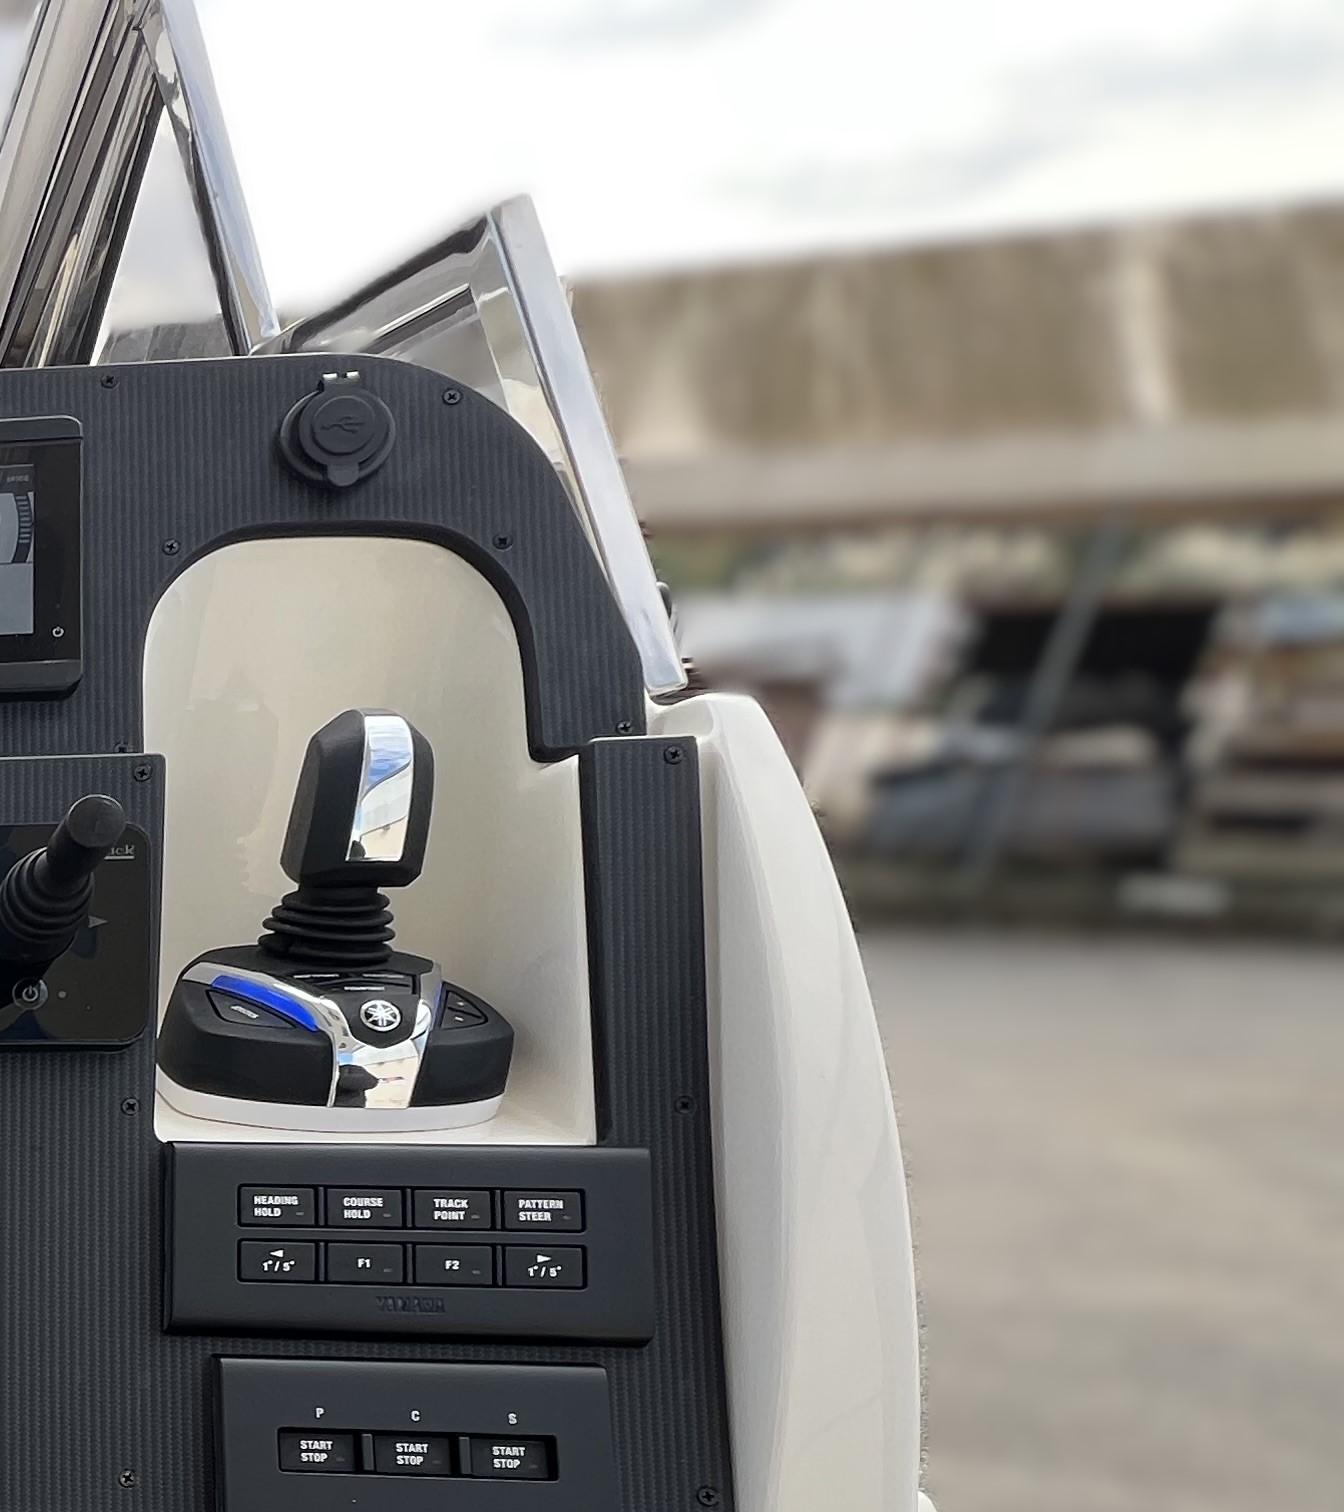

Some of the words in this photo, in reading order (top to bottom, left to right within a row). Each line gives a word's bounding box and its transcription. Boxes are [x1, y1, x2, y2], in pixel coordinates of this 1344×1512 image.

[253, 1195, 299, 1206] HEADING
[343, 1197, 384, 1208] COURSE
[433, 1198, 469, 1209] TRACK
[518, 1199, 564, 1210] PATTERN
[253, 1207, 282, 1217] HOLD
[343, 1209, 372, 1219] HOLD
[433, 1210, 466, 1221] POINT
[518, 1211, 552, 1222] STEER
[357, 1258, 372, 1268] F1
[444, 1260, 460, 1270] F2
[315, 1407, 325, 1418] P
[411, 1410, 420, 1422] C
[507, 1413, 518, 1425] S
[299, 1440, 333, 1450] START
[395, 1442, 429, 1453] START
[492, 1446, 526, 1457] START
[300, 1452, 328, 1463] STOP
[396, 1455, 424, 1466] STOP
[493, 1458, 521, 1469] STOP
